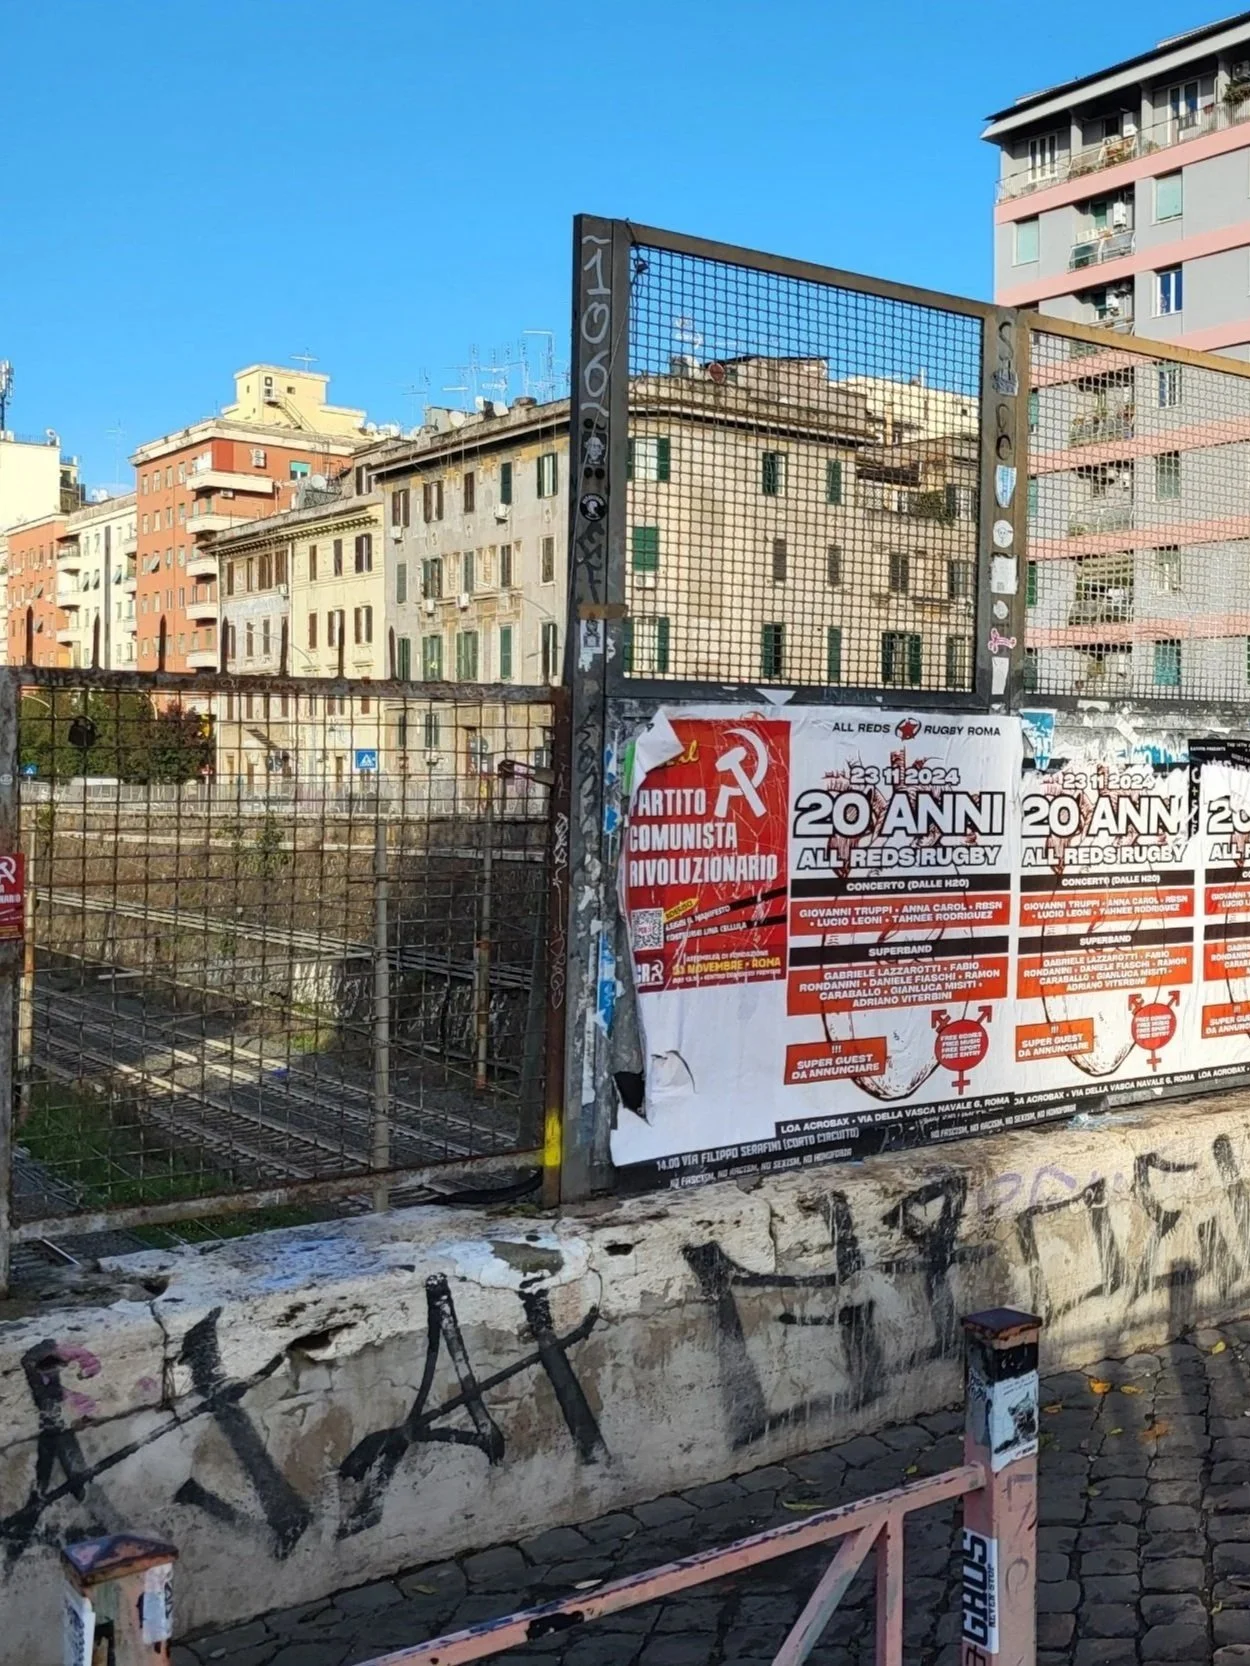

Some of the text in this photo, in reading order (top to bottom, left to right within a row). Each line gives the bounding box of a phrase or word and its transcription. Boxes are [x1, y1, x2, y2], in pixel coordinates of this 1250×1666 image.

[833, 723, 1000, 736] ALL REDS RUGBY ROMA
[850, 766, 960, 785] 23 11 2024
[1062, 773, 1156, 790] 23 11 2024
[631, 789, 706, 817] ARTITO
[793, 789, 1005, 837] 20 ANNI
[1021, 794, 1182, 838] 20 ANN
[630, 822, 737, 852] COMUNISTA
[797, 845, 1002, 870] ALL REDS RUGBY
[1022, 843, 1188, 867] ALL REDS RUGBY
[1209, 842, 1242, 861] ALL
[630, 854, 777, 887] RIVOLUZIONARIO
[846, 881, 905, 891] CONCERTO
[907, 880, 943, 890] (DALLE
[1062, 877, 1109, 886] CONCERTO
[1112, 876, 1141, 885] (DALLE
[800, 902, 1002, 918] GIOVANNI TRUPPI ANNA CAROL RBSN
[817, 911, 993, 927] LUCIO LEONI TAHNEE RODRIGUEZ
[1080, 934, 1131, 946] SUPERBAND
[869, 945, 932, 957] SUPERBAND
[687, 957, 780, 974] NOVEMBRE ROMA
[824, 962, 979, 981] GABRIELE LAZZAROTTI FABIO
[800, 970, 1000, 992] RONDANINI DANIELE FIASCHI RAMON
[819, 982, 977, 1001] CARABALLO GIANLUCA MISITI
[853, 992, 952, 1007] ADRIANO VITERBINI
[1022, 1033, 1084, 1048] SUPER GUEST
[832, 1045, 842, 1054] !!!
[1018, 1041, 1089, 1058] DA ANNUNCIARE
[797, 1054, 873, 1070] SUPER GUEST
[792, 1063, 880, 1080] DA ANNUNCIARE
[781, 1096, 1010, 1134] LOA ACROBAX VIA DELLA VASCA NAVALE 6, ROMA
[657, 1158, 681, 1171] 14.00
[681, 1153, 699, 1165] VIA
[702, 1148, 739, 1166] FILIPPO
[741, 1141, 781, 1157] SERAFINI
[784, 1133, 815, 1151] (CORTO
